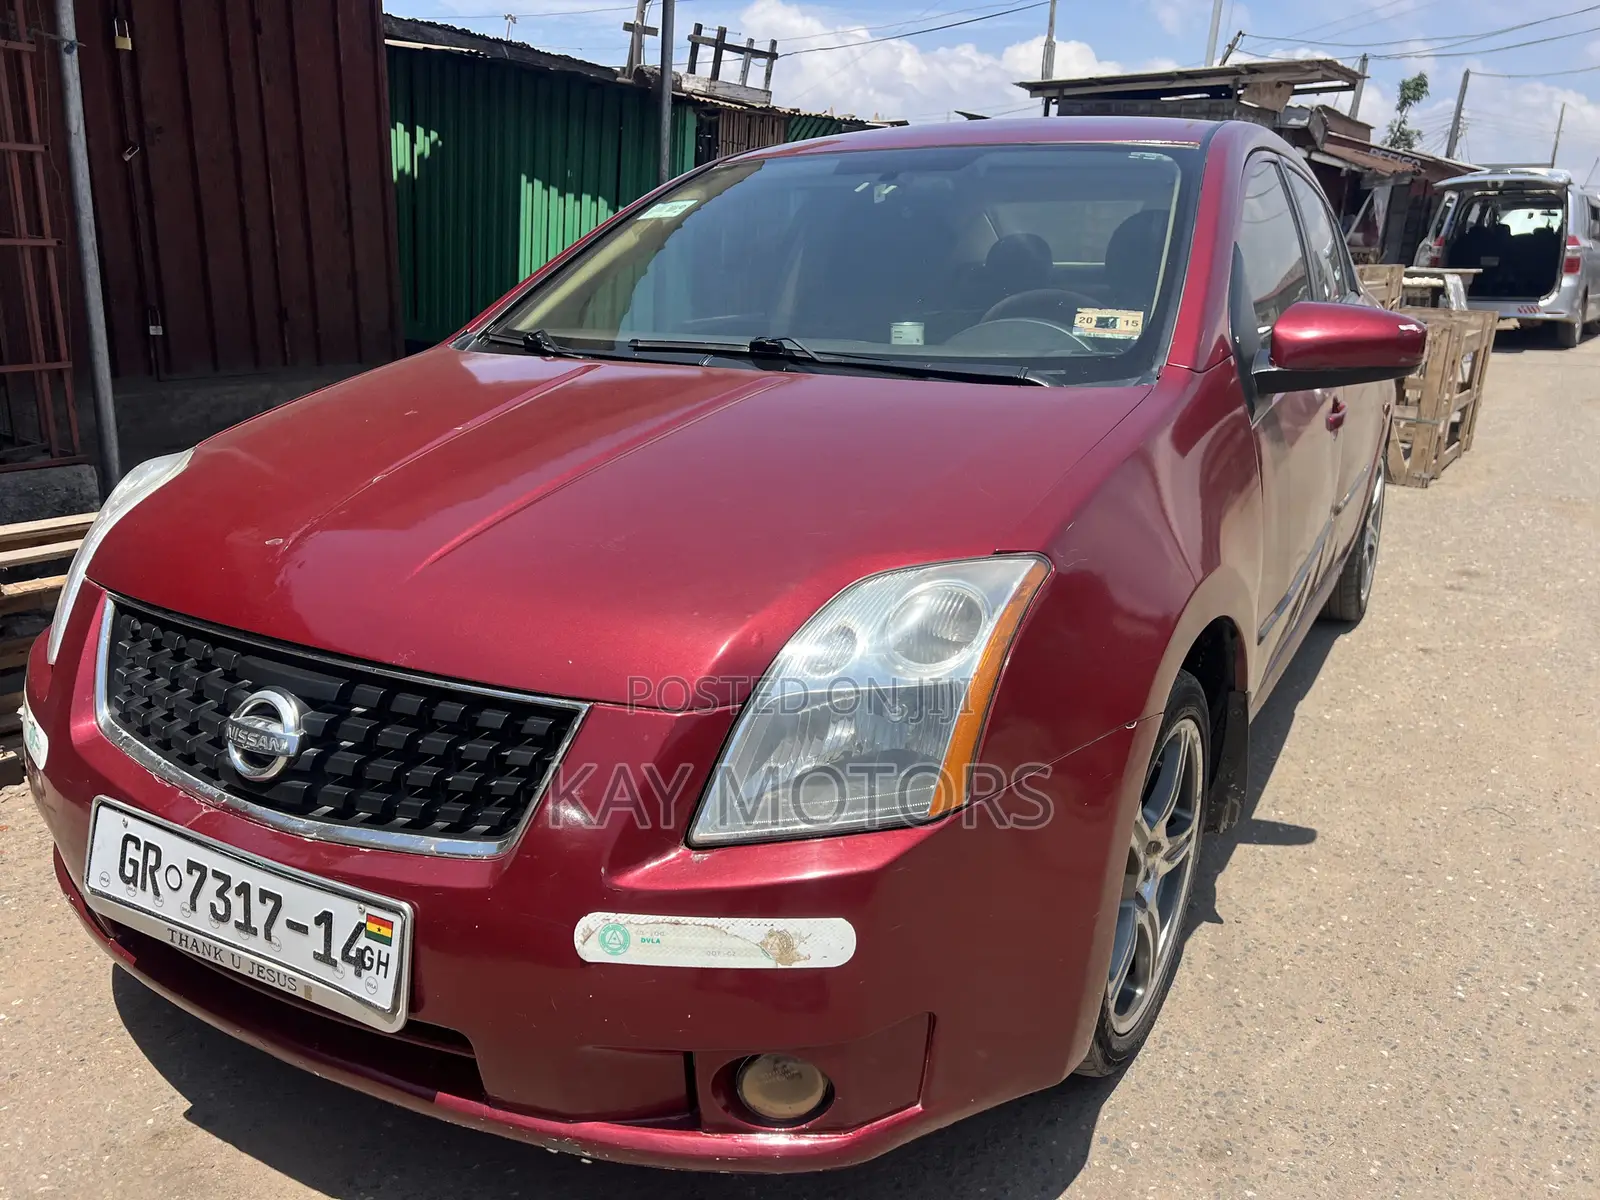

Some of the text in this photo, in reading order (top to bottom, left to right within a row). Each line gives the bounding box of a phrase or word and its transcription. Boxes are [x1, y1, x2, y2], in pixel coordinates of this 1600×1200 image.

[1078, 316, 1139, 327] 20 15
[226, 723, 283, 752] NISSAN
[118, 833, 366, 978] GR 7317-14
[640, 937, 661, 945] DVLA
[167, 928, 297, 992] THANK U JESUS
[361, 945, 390, 979] GH
